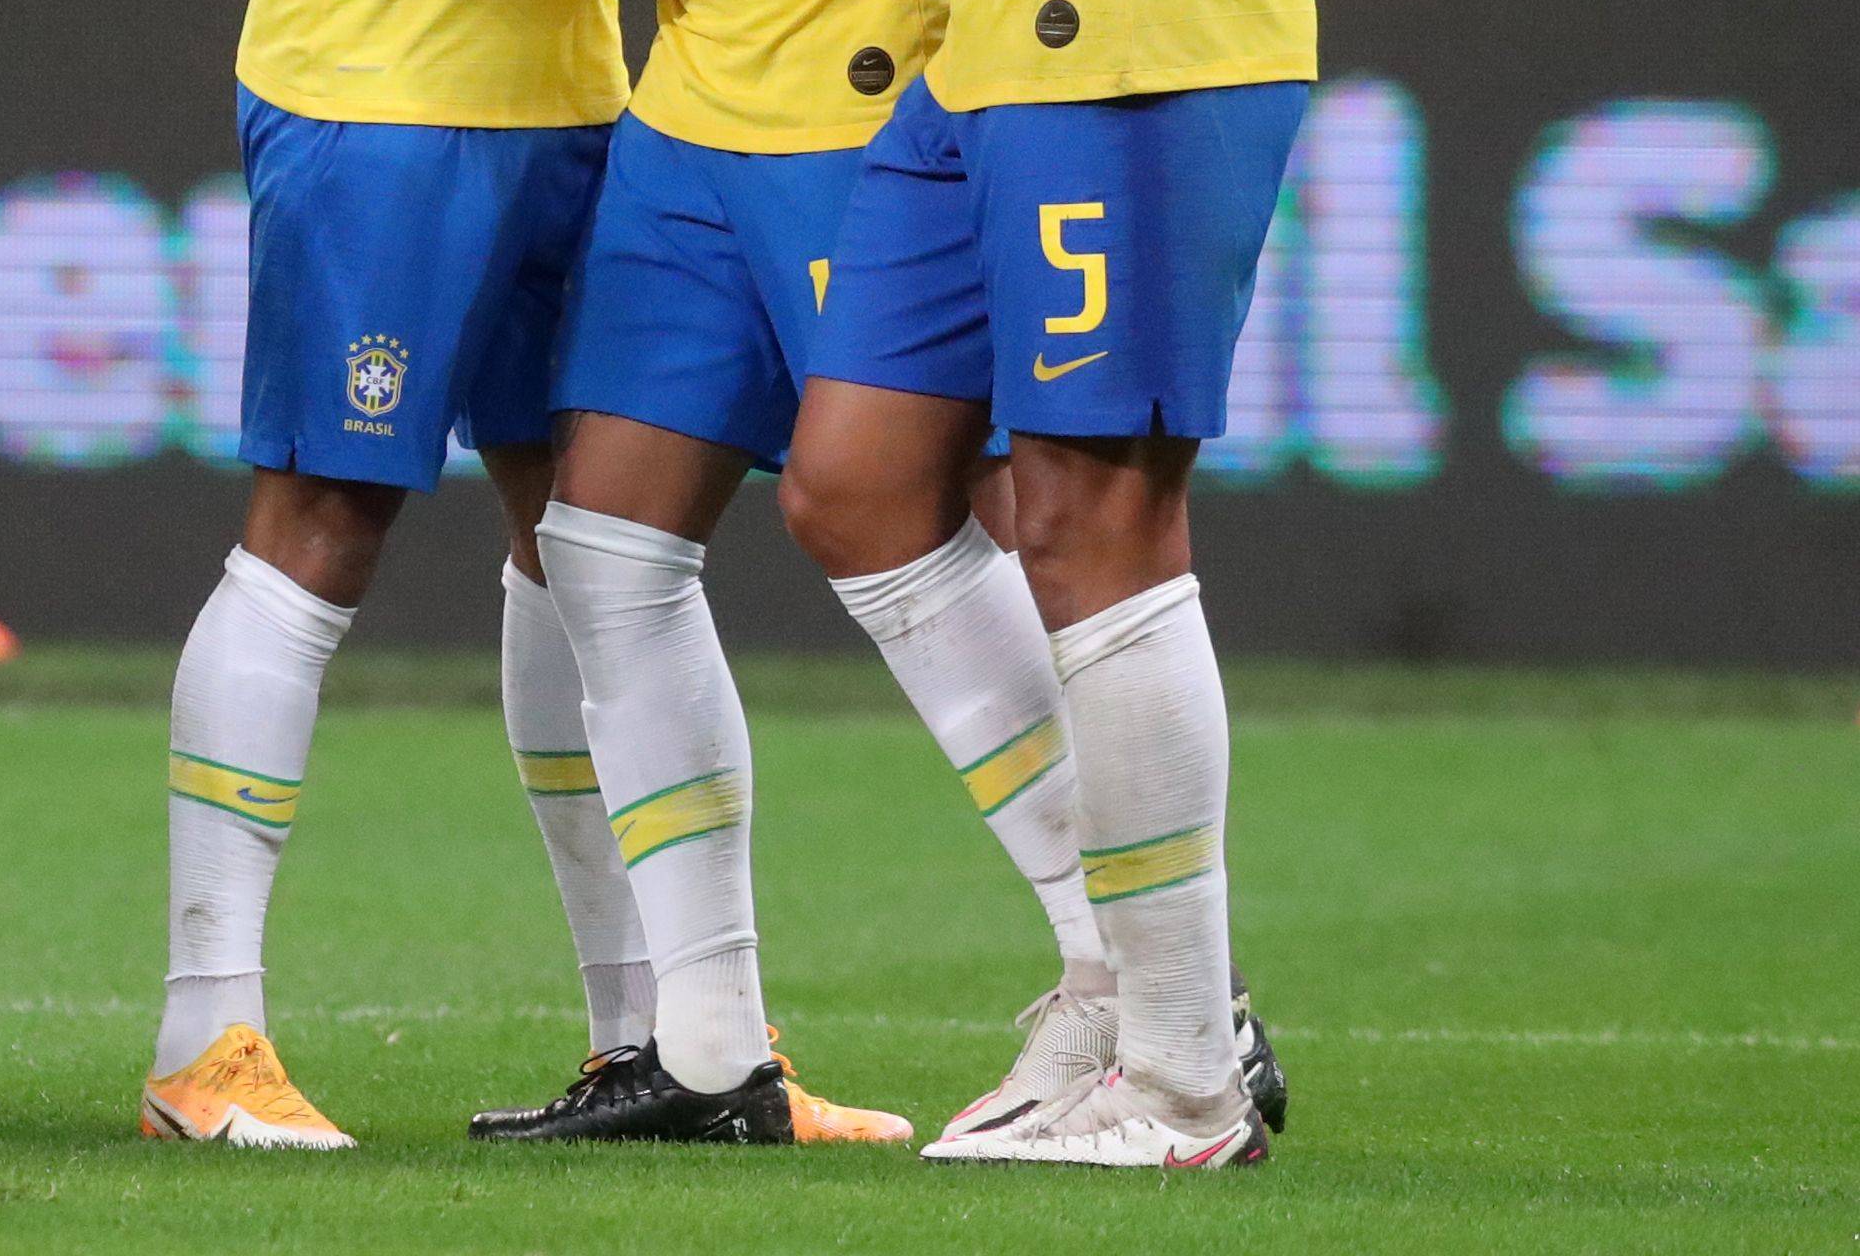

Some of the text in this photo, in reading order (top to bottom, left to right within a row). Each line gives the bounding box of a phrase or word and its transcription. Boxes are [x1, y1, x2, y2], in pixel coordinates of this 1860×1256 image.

[1039, 202, 1107, 334] 5
[366, 376, 384, 385] CBF
[343, 419, 395, 436] BRASIL
